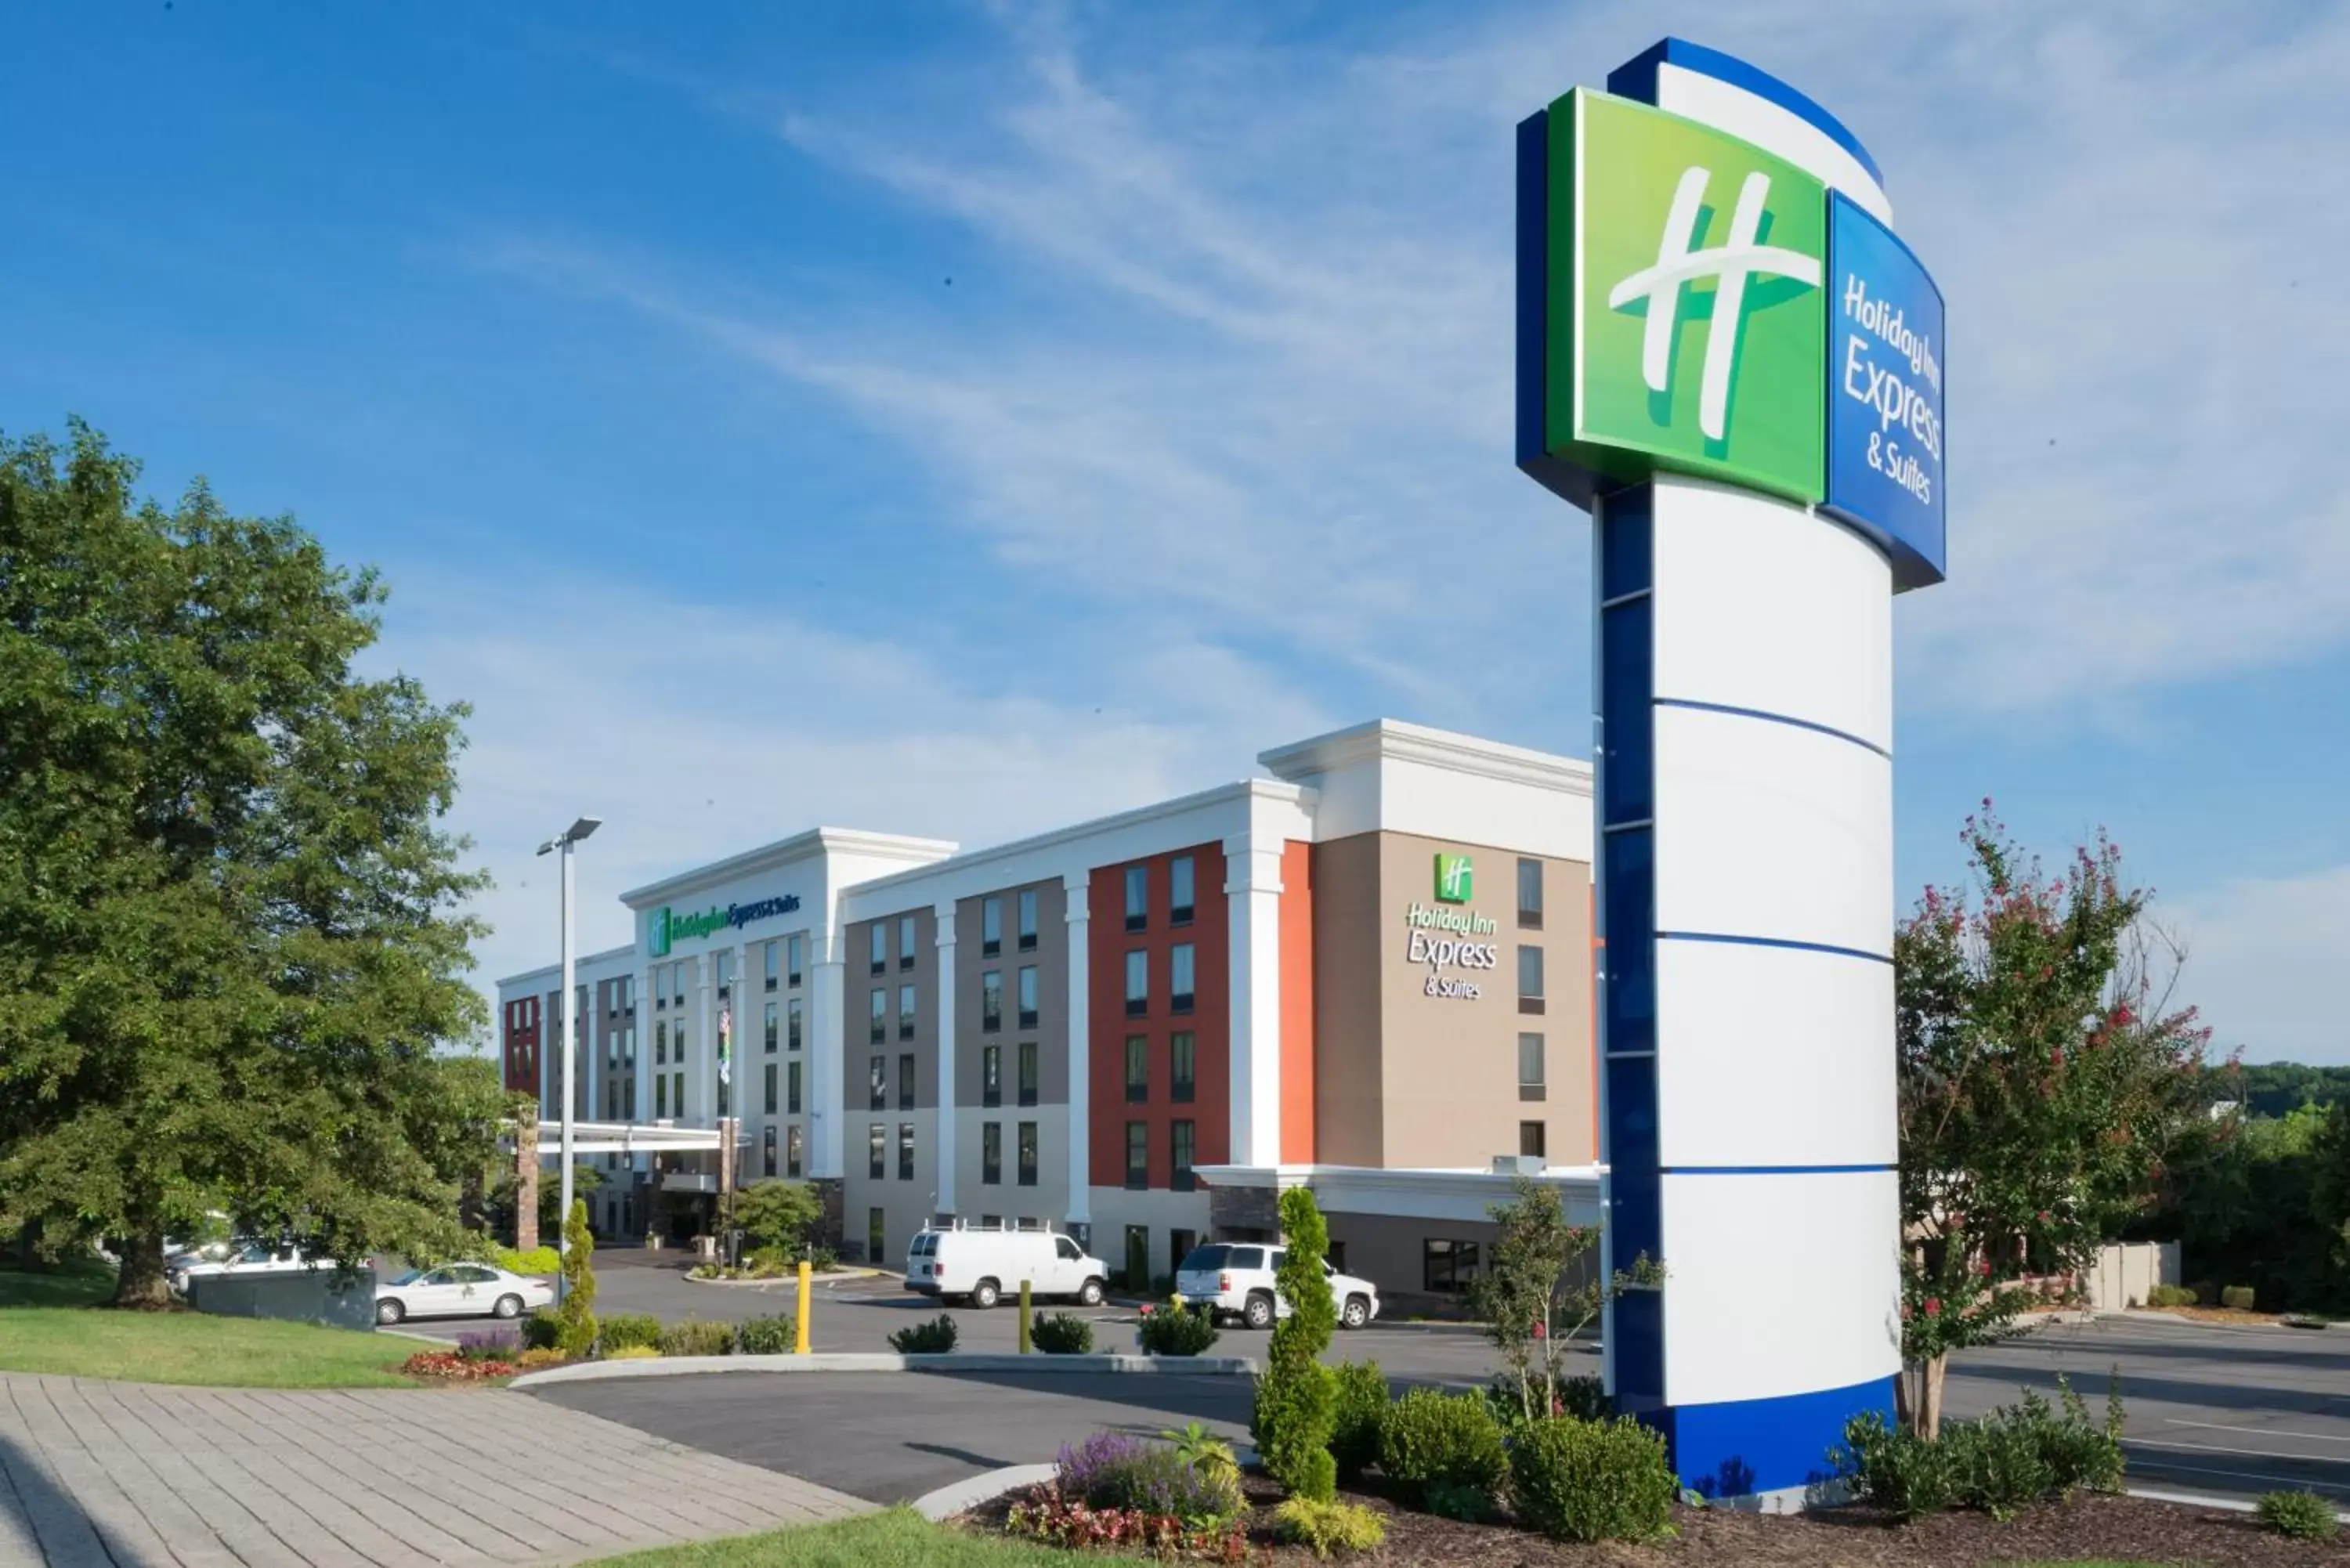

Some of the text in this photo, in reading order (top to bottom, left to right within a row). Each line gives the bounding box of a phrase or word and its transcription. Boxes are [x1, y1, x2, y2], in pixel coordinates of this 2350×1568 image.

[1844, 273, 1922, 375] Holiday
[1845, 334, 1940, 461] Express
[1867, 431, 1931, 505] & Suites
[1408, 901, 1471, 938] Holiday
[1409, 929, 1498, 971] Express
[1426, 976, 1481, 999] & Suites
